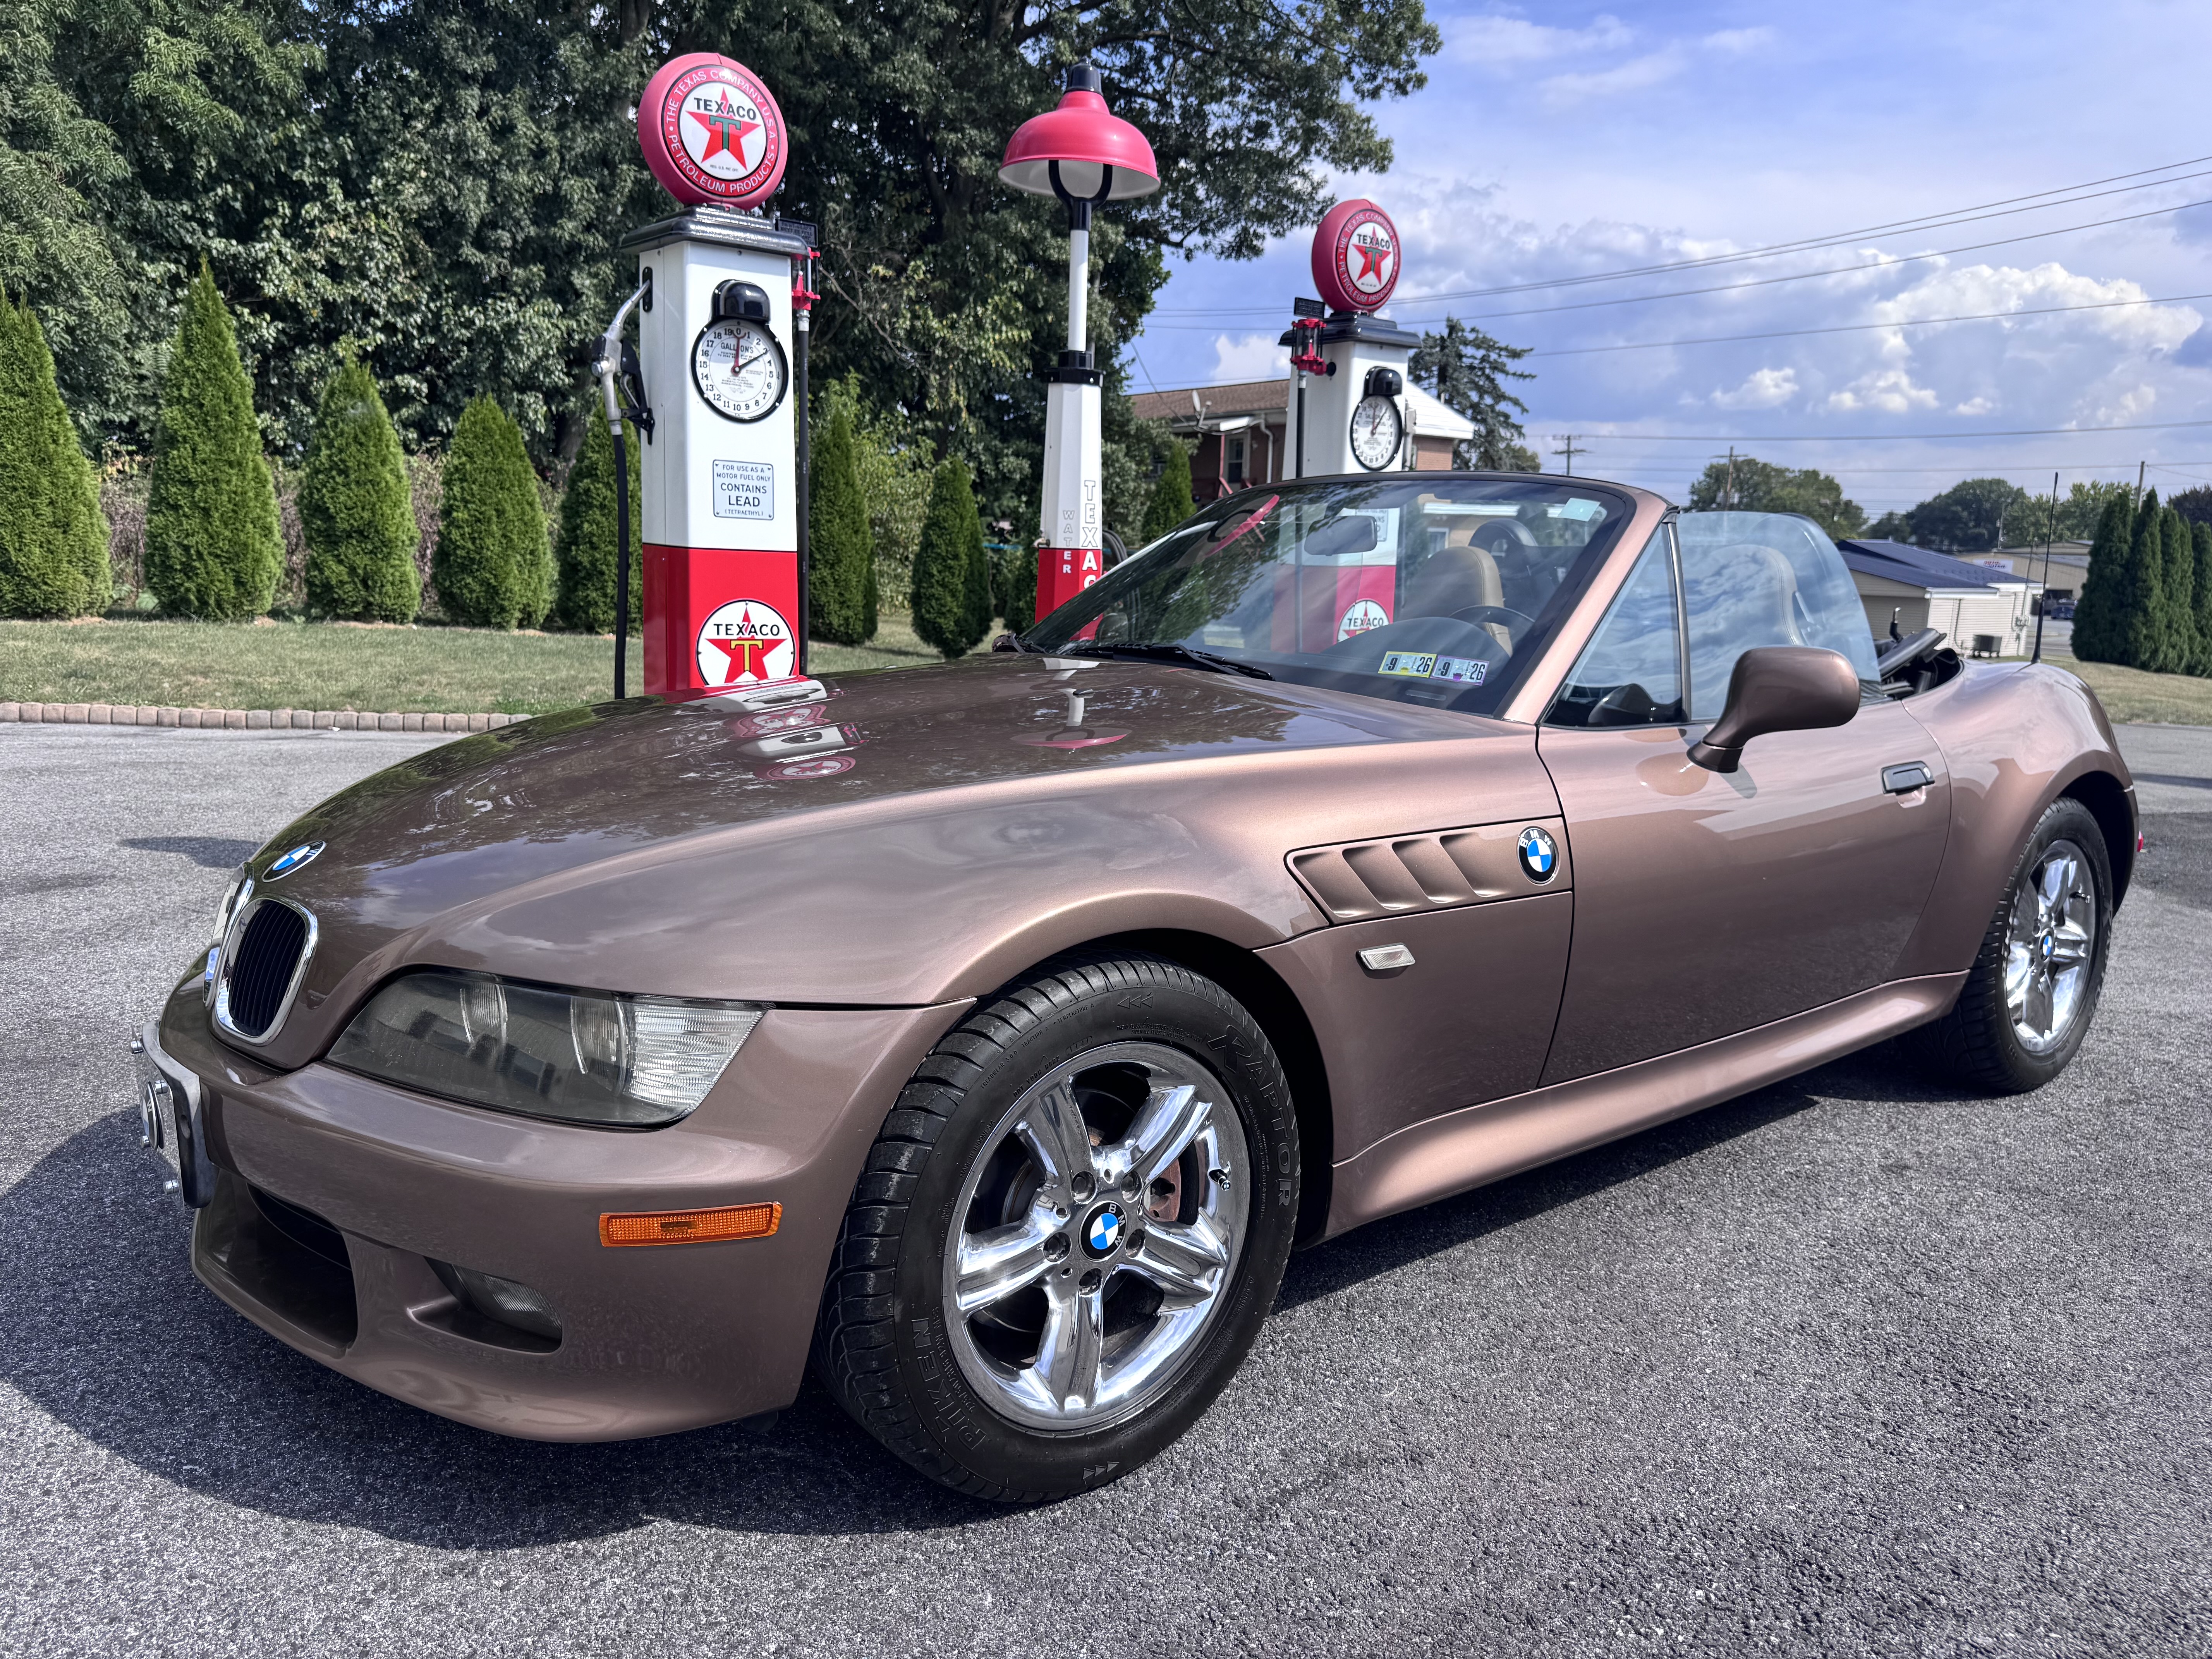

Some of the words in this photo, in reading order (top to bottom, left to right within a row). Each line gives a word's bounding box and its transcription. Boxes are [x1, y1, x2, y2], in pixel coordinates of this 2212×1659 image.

[666, 98, 679, 124] THE
[673, 71, 707, 96] TEXAS
[710, 69, 763, 103] COMPANY
[694, 97, 756, 120] TEXACO
[709, 115, 741, 150] T
[668, 134, 725, 192] PETROLEUM
[730, 152, 775, 193] PRODUCTS
[1339, 235, 1347, 252] THE
[1345, 214, 1365, 233] TEXAS
[1357, 234, 1390, 249] TEXACO
[1338, 262, 1367, 303] PETROLEUM
[721, 342, 754, 354] GALLONS
[720, 483, 767, 494] CONTAINS
[728, 495, 760, 507] LEAD
[1063, 510, 1075, 574] WATER
[713, 623, 780, 636] TEXACO
[1347, 617, 1384, 628] TEXACO
[730, 639, 764, 672] T
[1388, 657, 1398, 671] 9
[1416, 656, 1432, 672] 26
[1441, 662, 1451, 676] 9
[1469, 663, 1486, 680] 26
[1519, 830, 1552, 848] BMW
[981, 1062, 1005, 1089] TREADWEAR
[1005, 1050, 1018, 1062] 300
[1021, 1030, 1043, 1048] TRACTION
[1056, 1005, 1089, 1024] TEMPERATURE
[1207, 1024, 1293, 1207] RAPTOR
[959, 1161, 970, 1178] MADE
[968, 1151, 975, 1160] IN
[973, 1120, 995, 1152] INDONESIA
[1108, 1203, 1125, 1246] BMW
[911, 1317, 987, 1450] RIKEN
